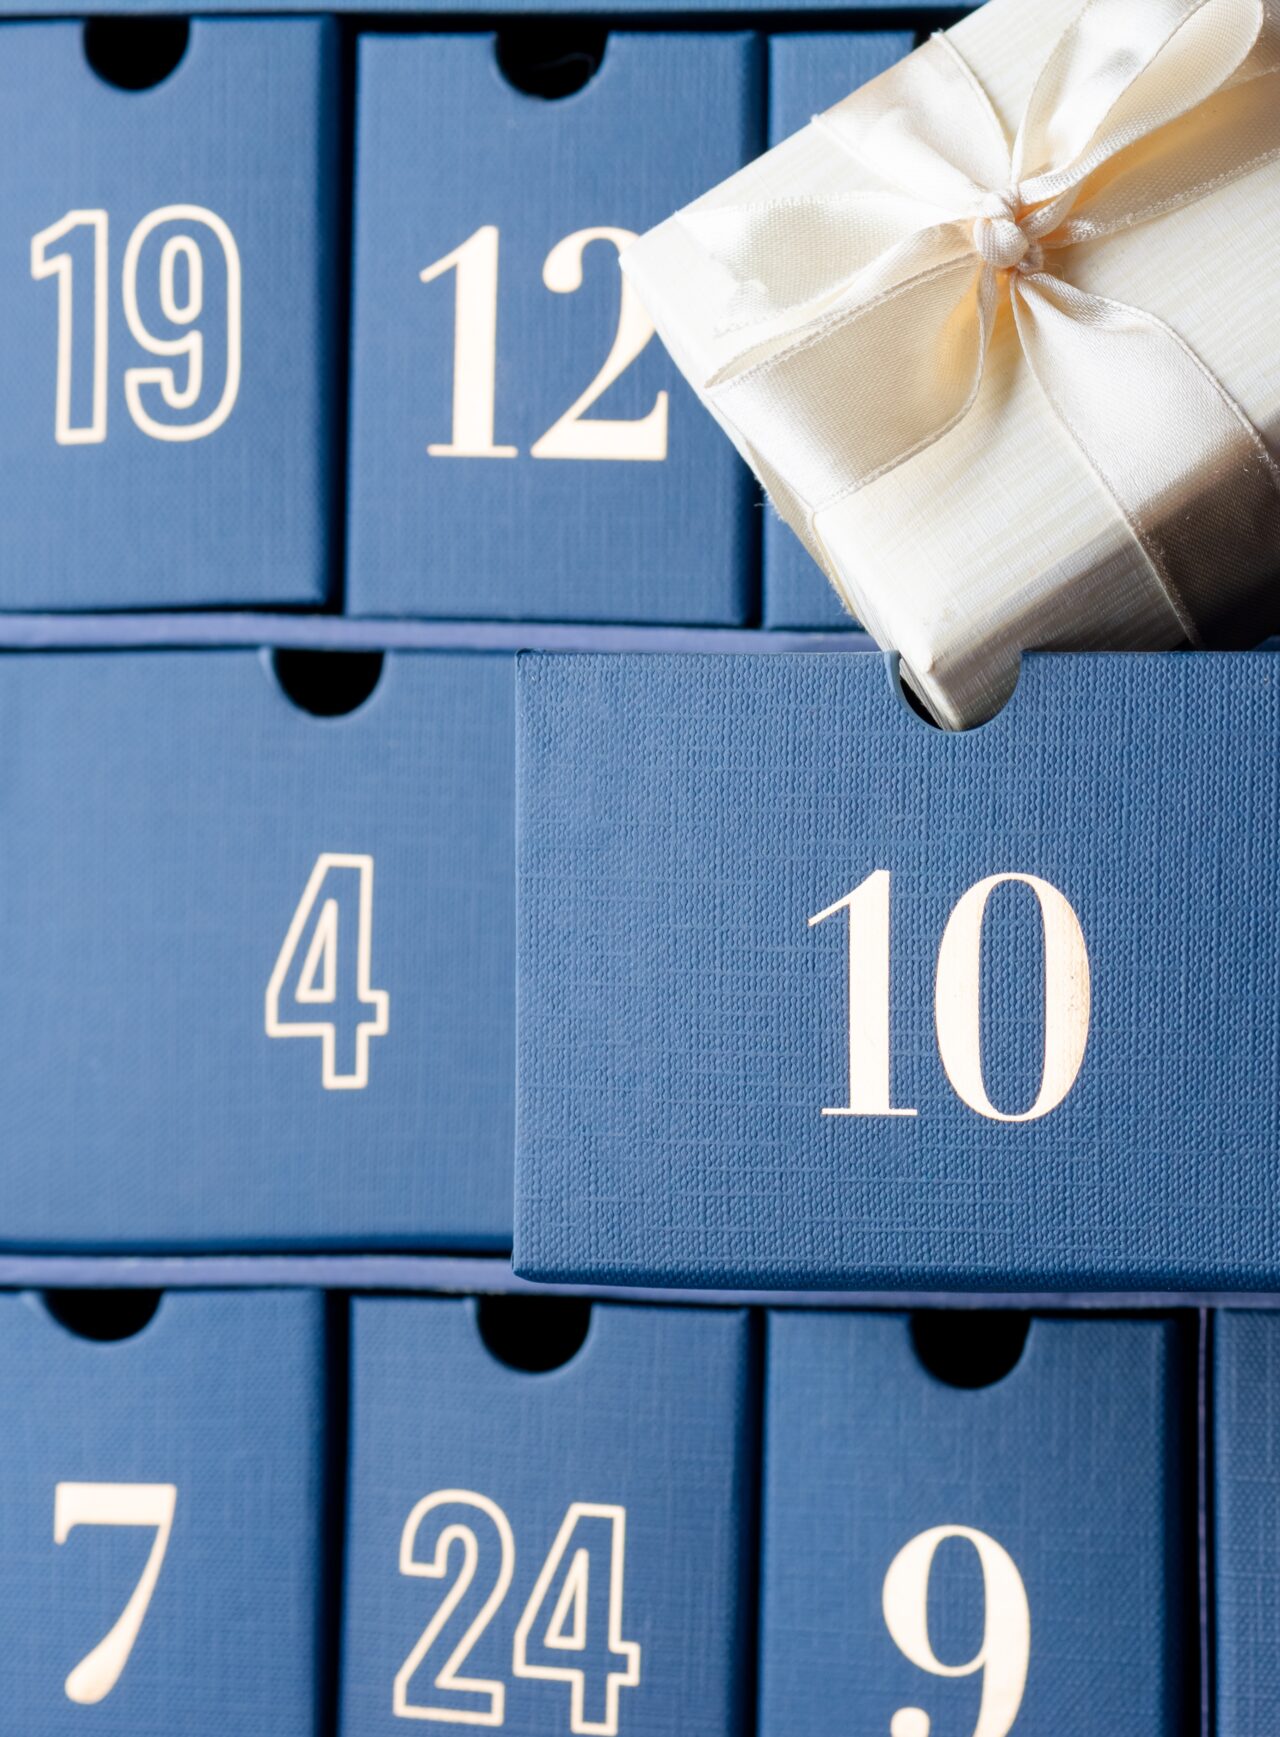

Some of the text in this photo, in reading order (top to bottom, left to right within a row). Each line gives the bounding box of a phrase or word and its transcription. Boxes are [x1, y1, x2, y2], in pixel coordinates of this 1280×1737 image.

[30, 204, 243, 446] 19
[419, 225, 671, 463] 12
[265, 853, 391, 1092] 4
[807, 869, 1092, 1124] 10
[52, 1482, 178, 1705] 7
[393, 1488, 641, 1736] 24
[881, 1524, 1031, 1737] 9
